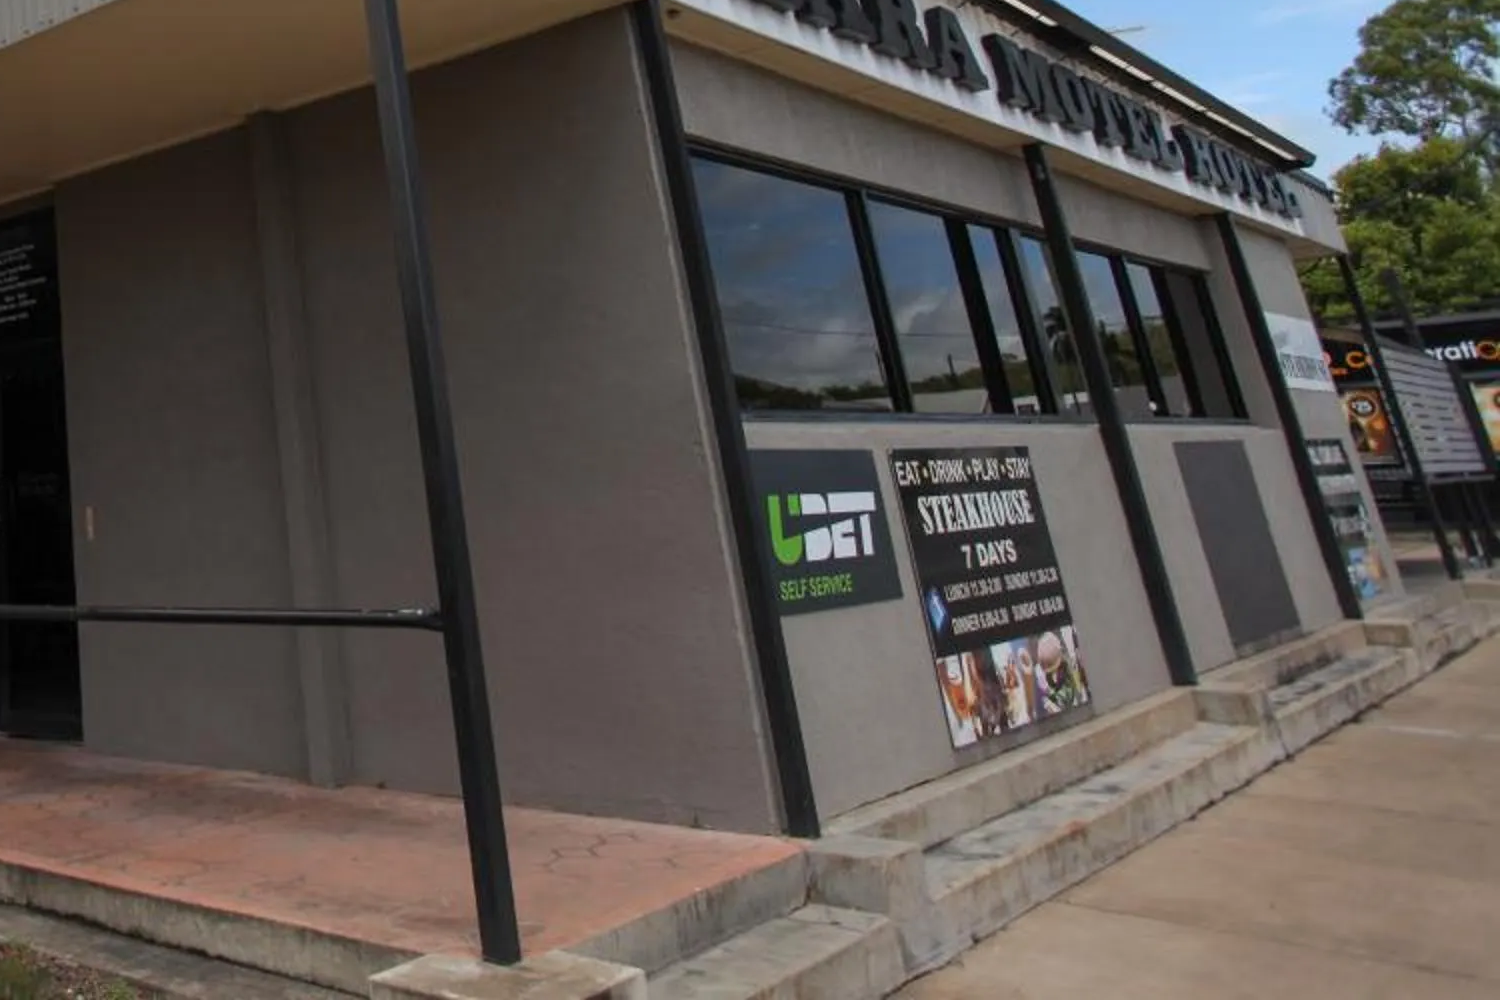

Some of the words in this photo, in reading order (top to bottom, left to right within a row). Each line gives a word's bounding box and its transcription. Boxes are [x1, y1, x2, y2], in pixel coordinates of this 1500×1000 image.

[981, 33, 1184, 172] MOTEL
[1171, 124, 1302, 219] HOTEL
[894, 460, 922, 486] EAT
[928, 458, 969, 484] DRINK
[972, 457, 1001, 482] PLAY
[1005, 456, 1031, 480] STAY
[767, 491, 877, 565] UBET
[917, 489, 1036, 536] STEAKHOUSE
[961, 544, 973, 569] 7
[976, 539, 1018, 567] DAYS
